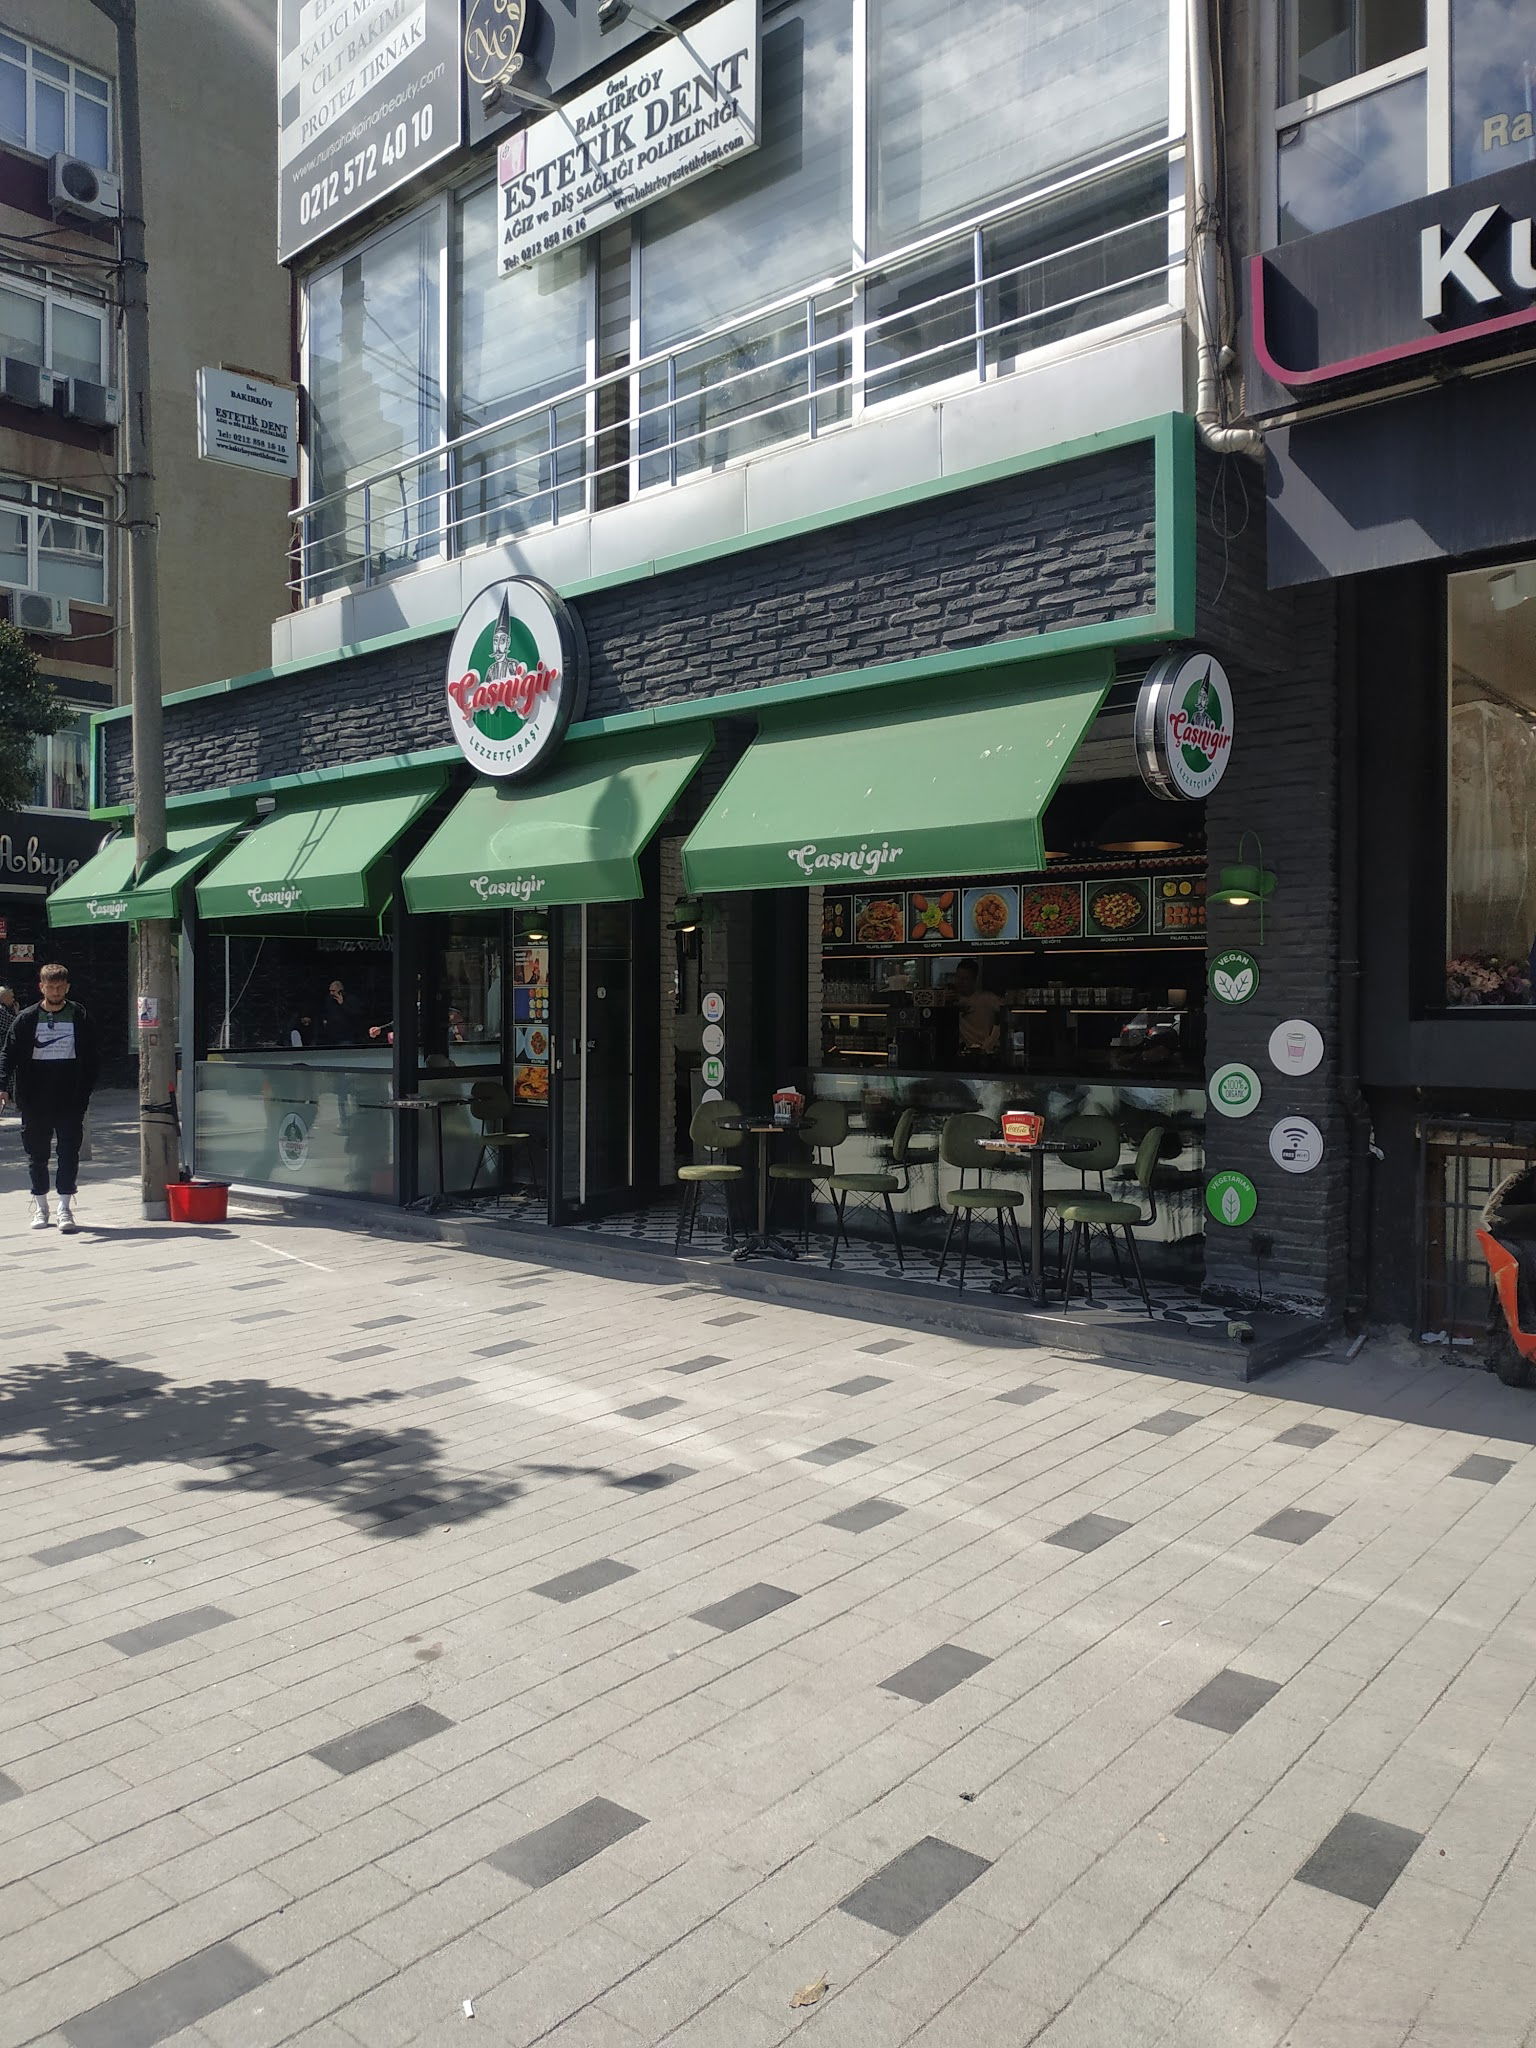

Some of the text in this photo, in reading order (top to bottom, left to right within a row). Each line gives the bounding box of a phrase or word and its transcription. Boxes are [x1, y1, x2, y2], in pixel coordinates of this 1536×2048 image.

[300, 8, 349, 72] KALICI
[301, 17, 423, 145] PROTEZ TIRNAK
[312, 50, 345, 95] CİLT
[606, 74, 628, 96] Özel
[574, 68, 663, 136] BAKIRKÖY
[504, 48, 749, 221] ESTETİK DENT
[300, 104, 433, 226] 0212 572 40 10
[504, 97, 740, 245] AĞIZ ve DİŞ SAĞLIĞI POLİKLİNİĞİ
[503, 254, 520, 271] Tel:
[521, 242, 542, 262] 0212
[562, 224, 573, 241] 16
[576, 217, 586, 234] 16
[230, 390, 273, 408] BAKIRKÖY
[215, 407, 289, 434] ESTETİK DENT
[233, 433, 251, 444] 0212
[448, 661, 559, 721] Çaşnigir
[469, 723, 540, 763] LEZZETÇİBAŞI
[1169, 711, 1231, 760] Çaşnigir
[788, 841, 904, 876] Çaşnigir
[247, 885, 303, 908] Çaşnigir
[470, 875, 545, 901] Çaşnigir
[86, 900, 128, 919] Çaşnigir
[1218, 953, 1249, 966] VEGAN
[1227, 1079, 1244, 1089] 100%
[1210, 1175, 1251, 1192] VEGETARIAN
